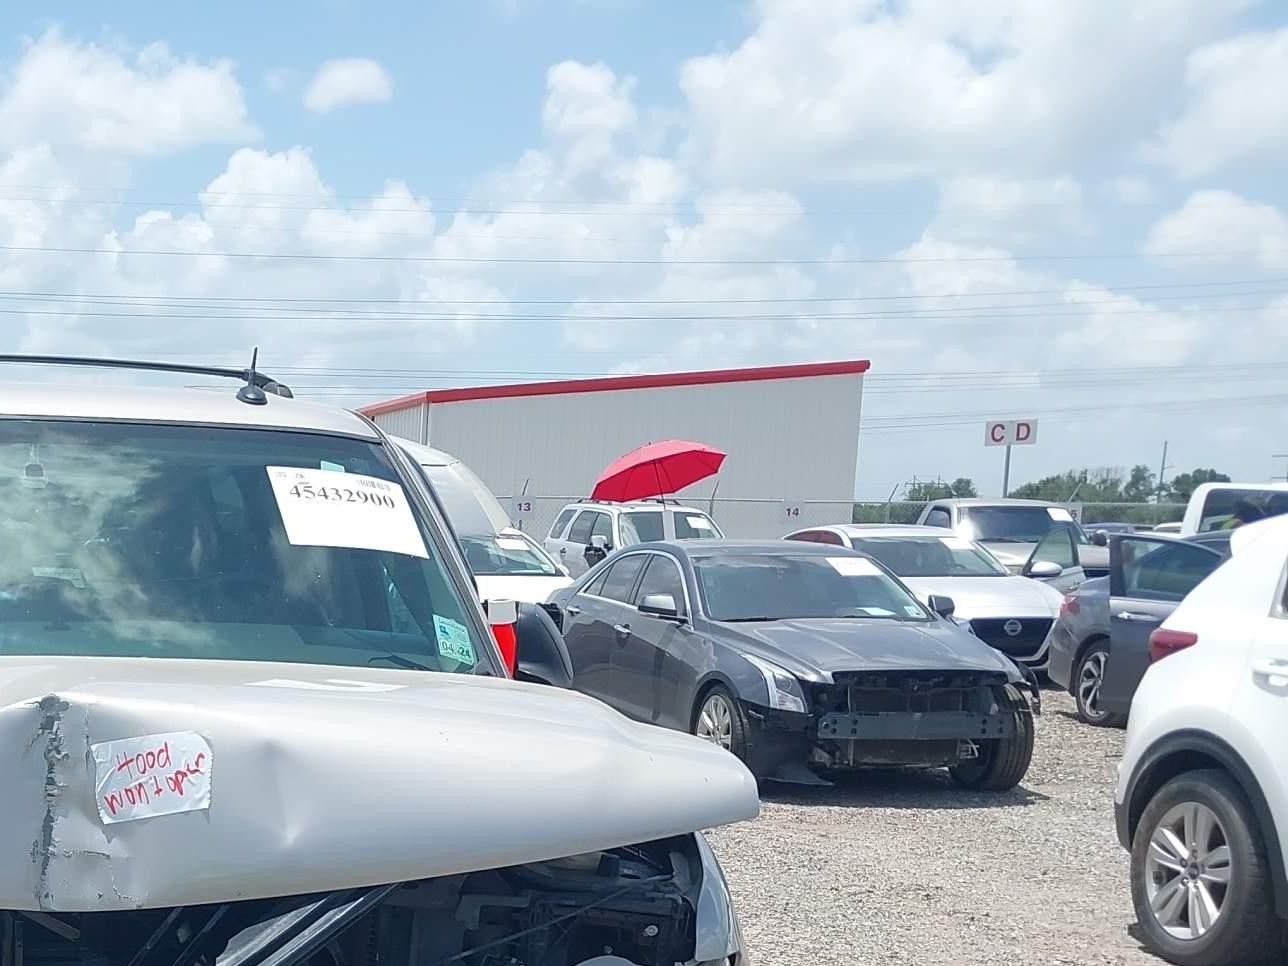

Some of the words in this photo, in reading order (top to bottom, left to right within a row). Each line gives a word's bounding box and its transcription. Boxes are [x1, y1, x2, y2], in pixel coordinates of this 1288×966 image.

[991, 423, 1005, 442] C
[1015, 422, 1031, 442] D
[289, 485, 396, 509] 45432900
[517, 502, 532, 512] 13
[785, 507, 799, 517] 14
